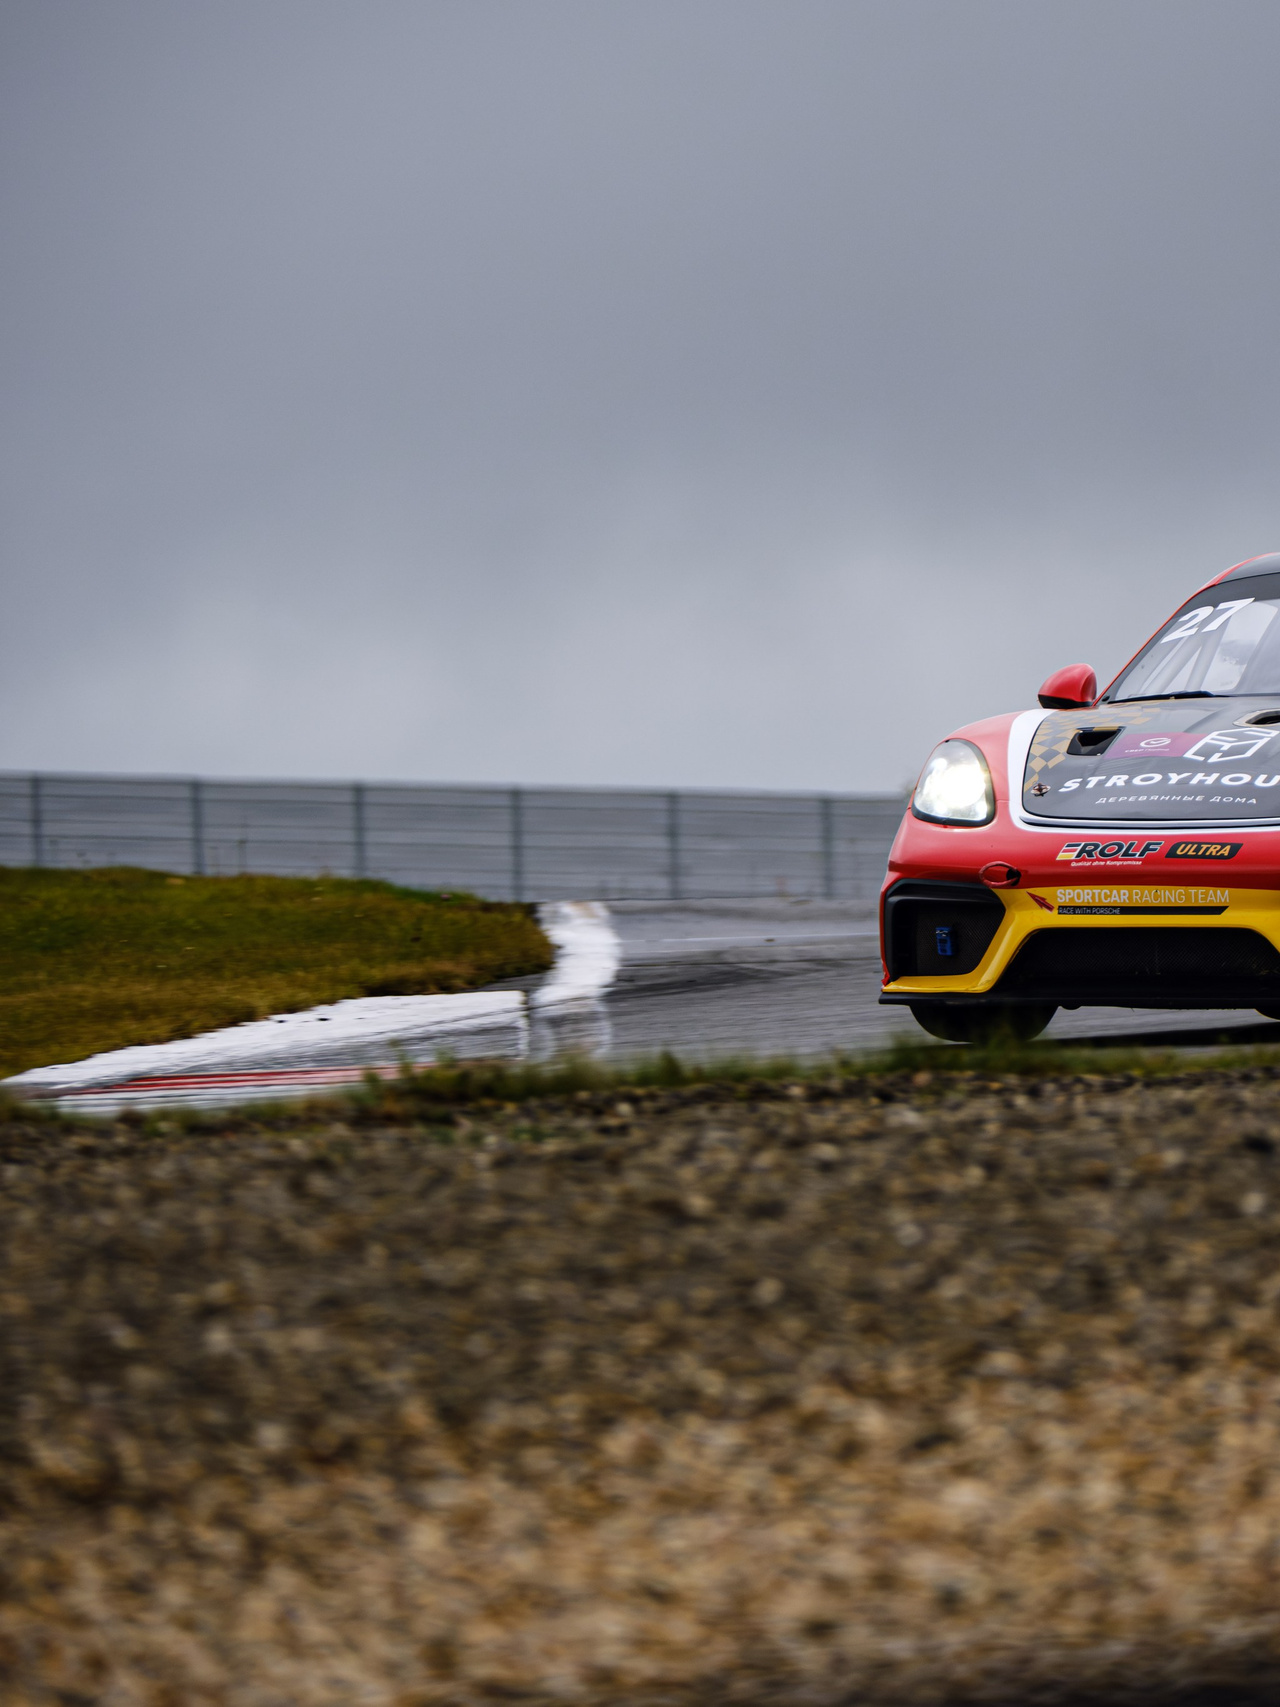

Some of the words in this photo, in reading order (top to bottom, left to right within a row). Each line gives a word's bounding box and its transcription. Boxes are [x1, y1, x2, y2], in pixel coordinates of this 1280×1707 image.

[1160, 597, 1255, 644] 27
[1094, 794, 1205, 805] ДЕРЕВЯННЫЕ
[1209, 795, 1257, 804] ДОМА
[1074, 840, 1165, 860] ROLF
[1175, 843, 1233, 857] ULTRA
[1056, 888, 1130, 903] SPORTCAR
[1132, 889, 1186, 903] RACING
[1188, 889, 1230, 903] TEAM
[1058, 906, 1075, 915] RACE
[1075, 906, 1091, 914] WITH
[1091, 906, 1121, 914] PORSCHE
